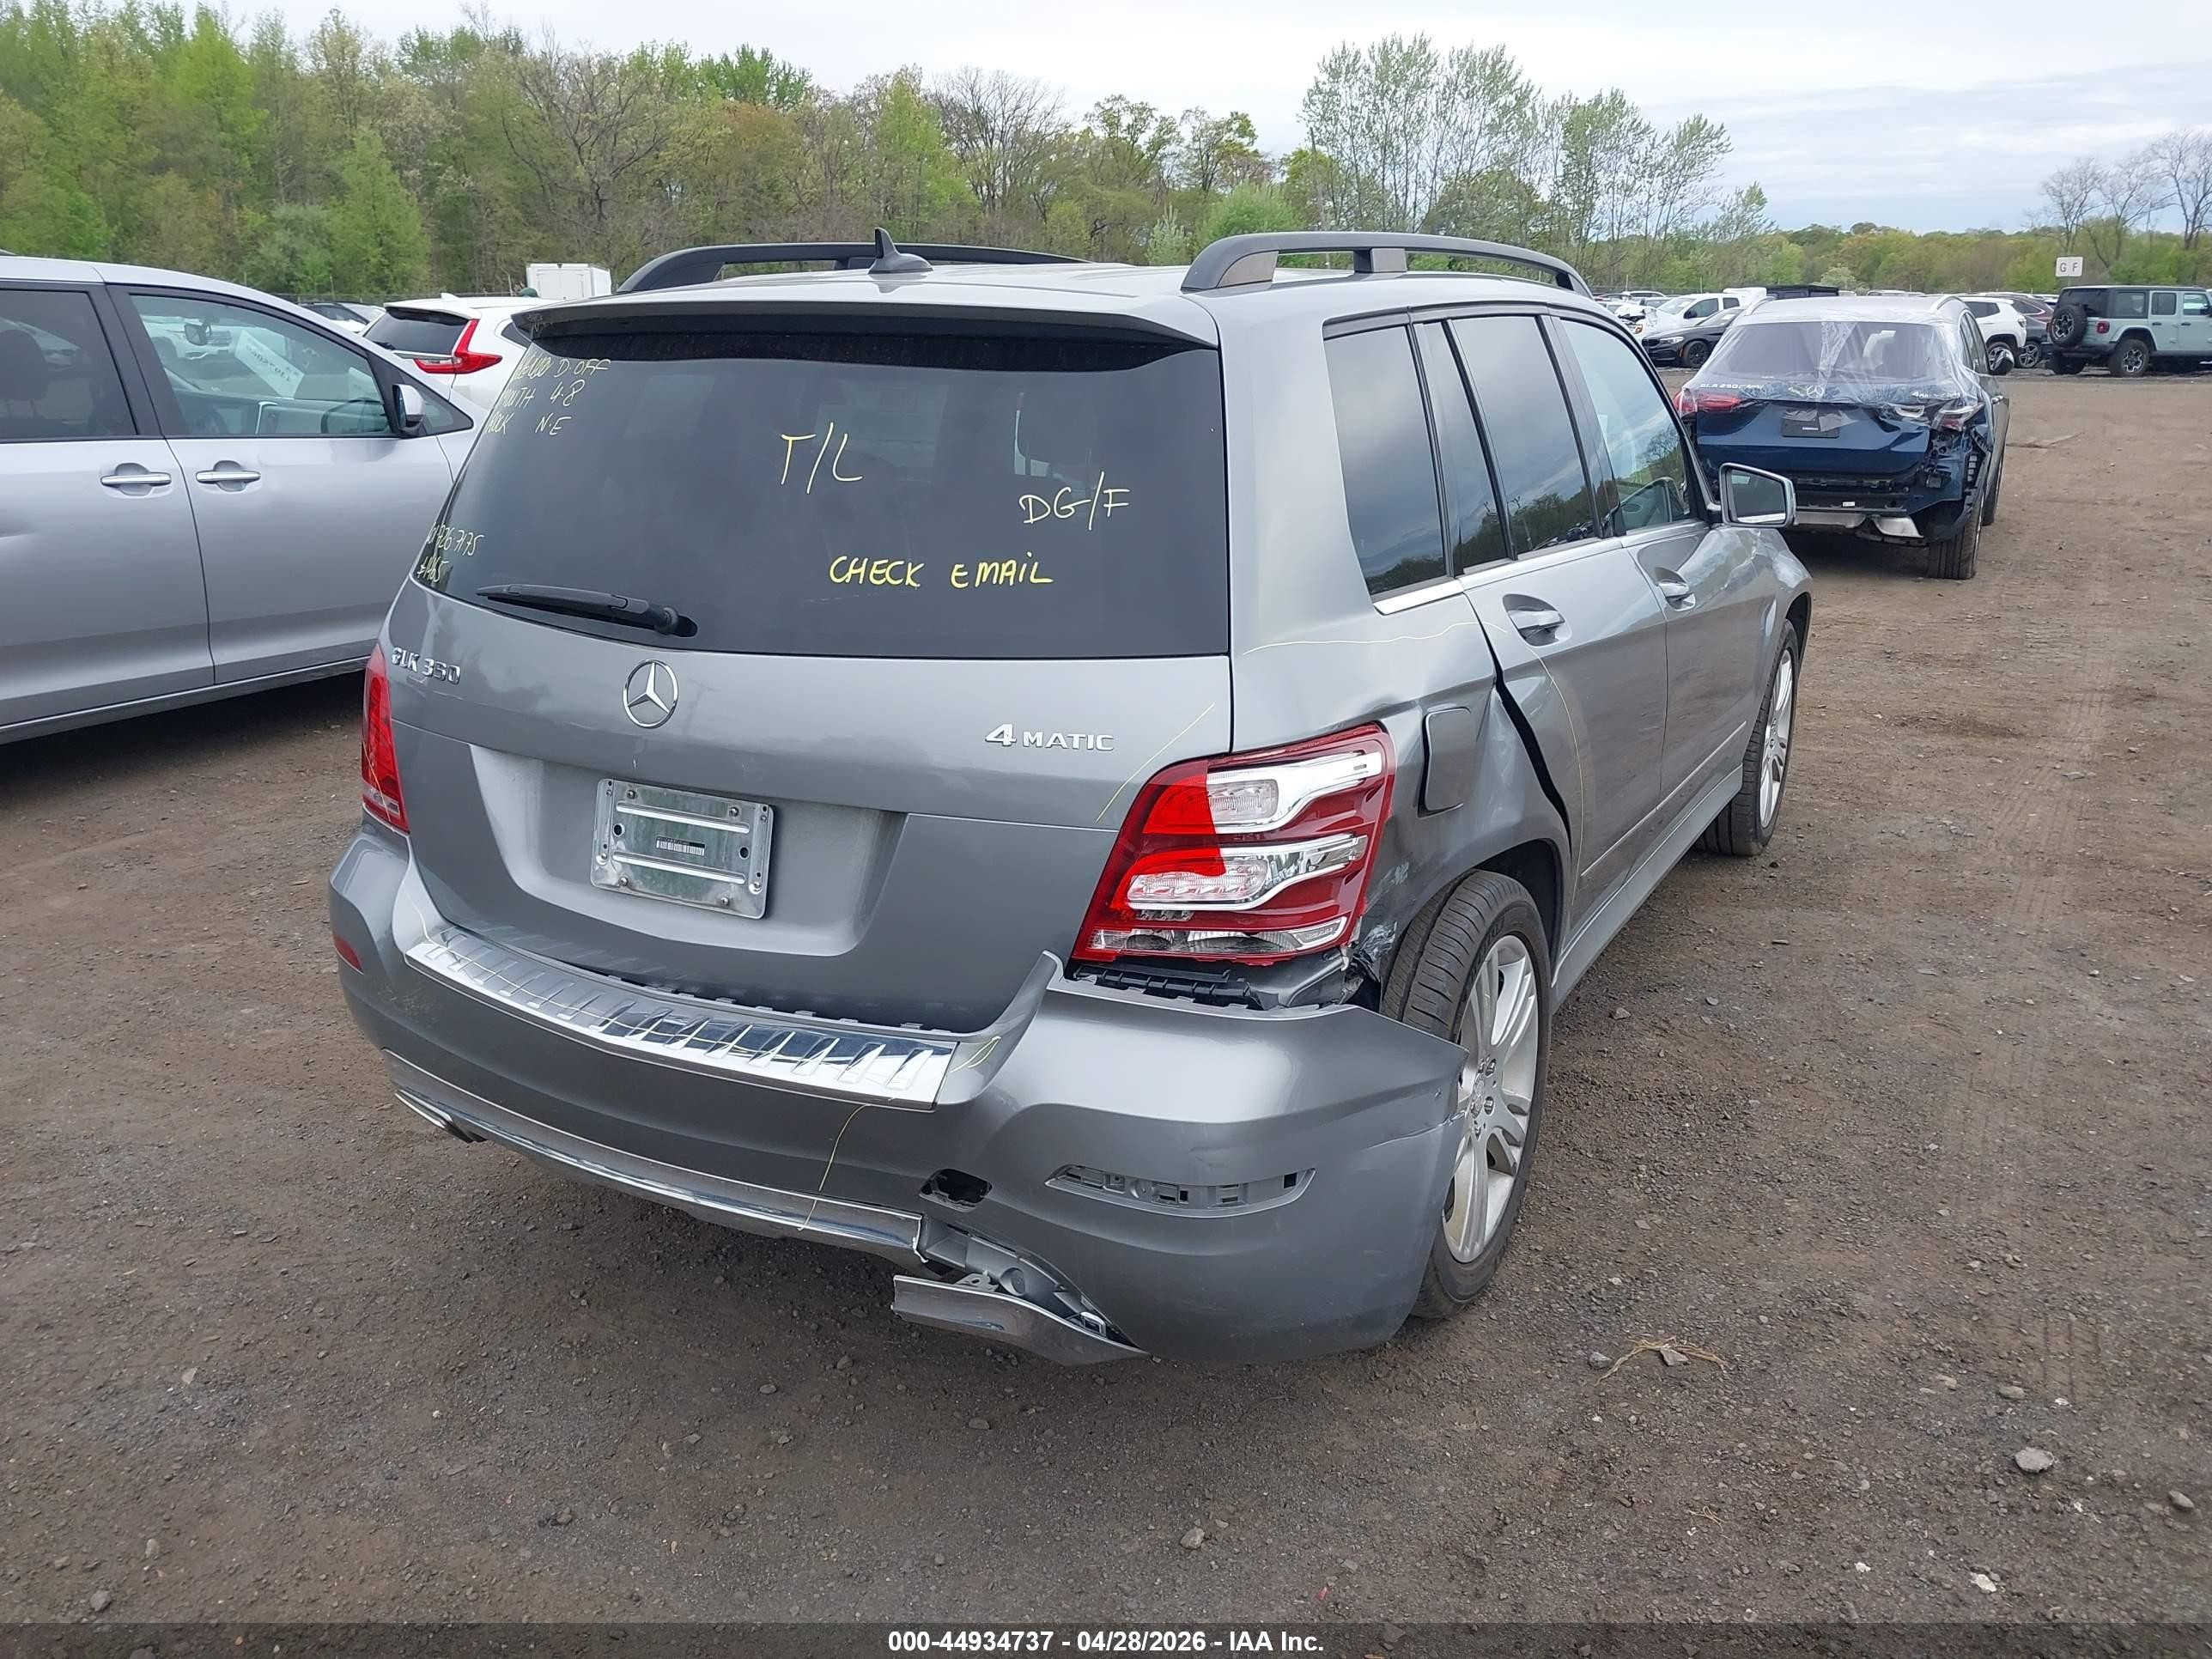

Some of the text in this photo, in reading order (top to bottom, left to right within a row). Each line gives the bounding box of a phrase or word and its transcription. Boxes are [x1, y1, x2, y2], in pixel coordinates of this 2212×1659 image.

[781, 422, 863, 494] T/L
[829, 556, 925, 587] CHECK
[392, 647, 461, 685] GLK 350
